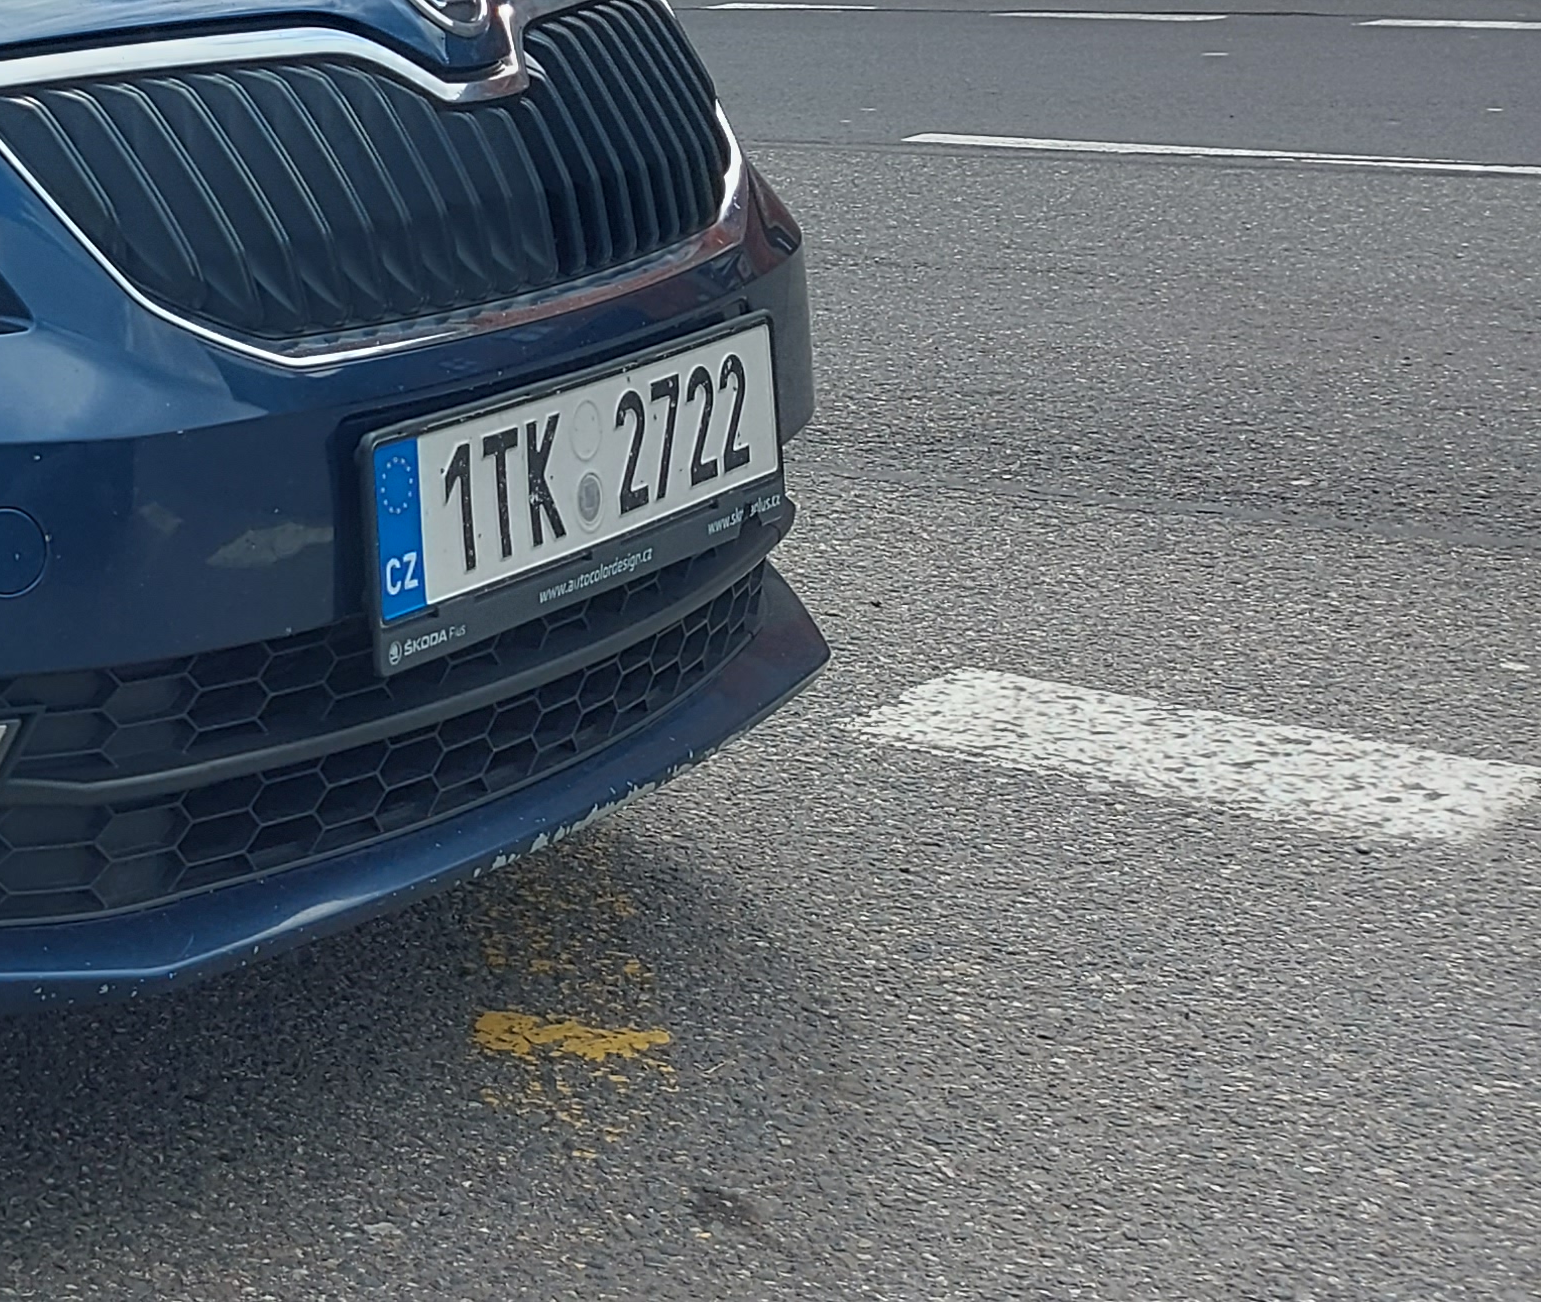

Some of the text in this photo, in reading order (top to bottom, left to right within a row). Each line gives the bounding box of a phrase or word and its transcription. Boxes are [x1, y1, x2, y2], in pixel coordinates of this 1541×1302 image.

[442, 353, 751, 573] 1TK 2722
[385, 550, 419, 596] CZ
[539, 548, 653, 604] www.autocolordesign.cz
[403, 628, 448, 657] ŠKODA
